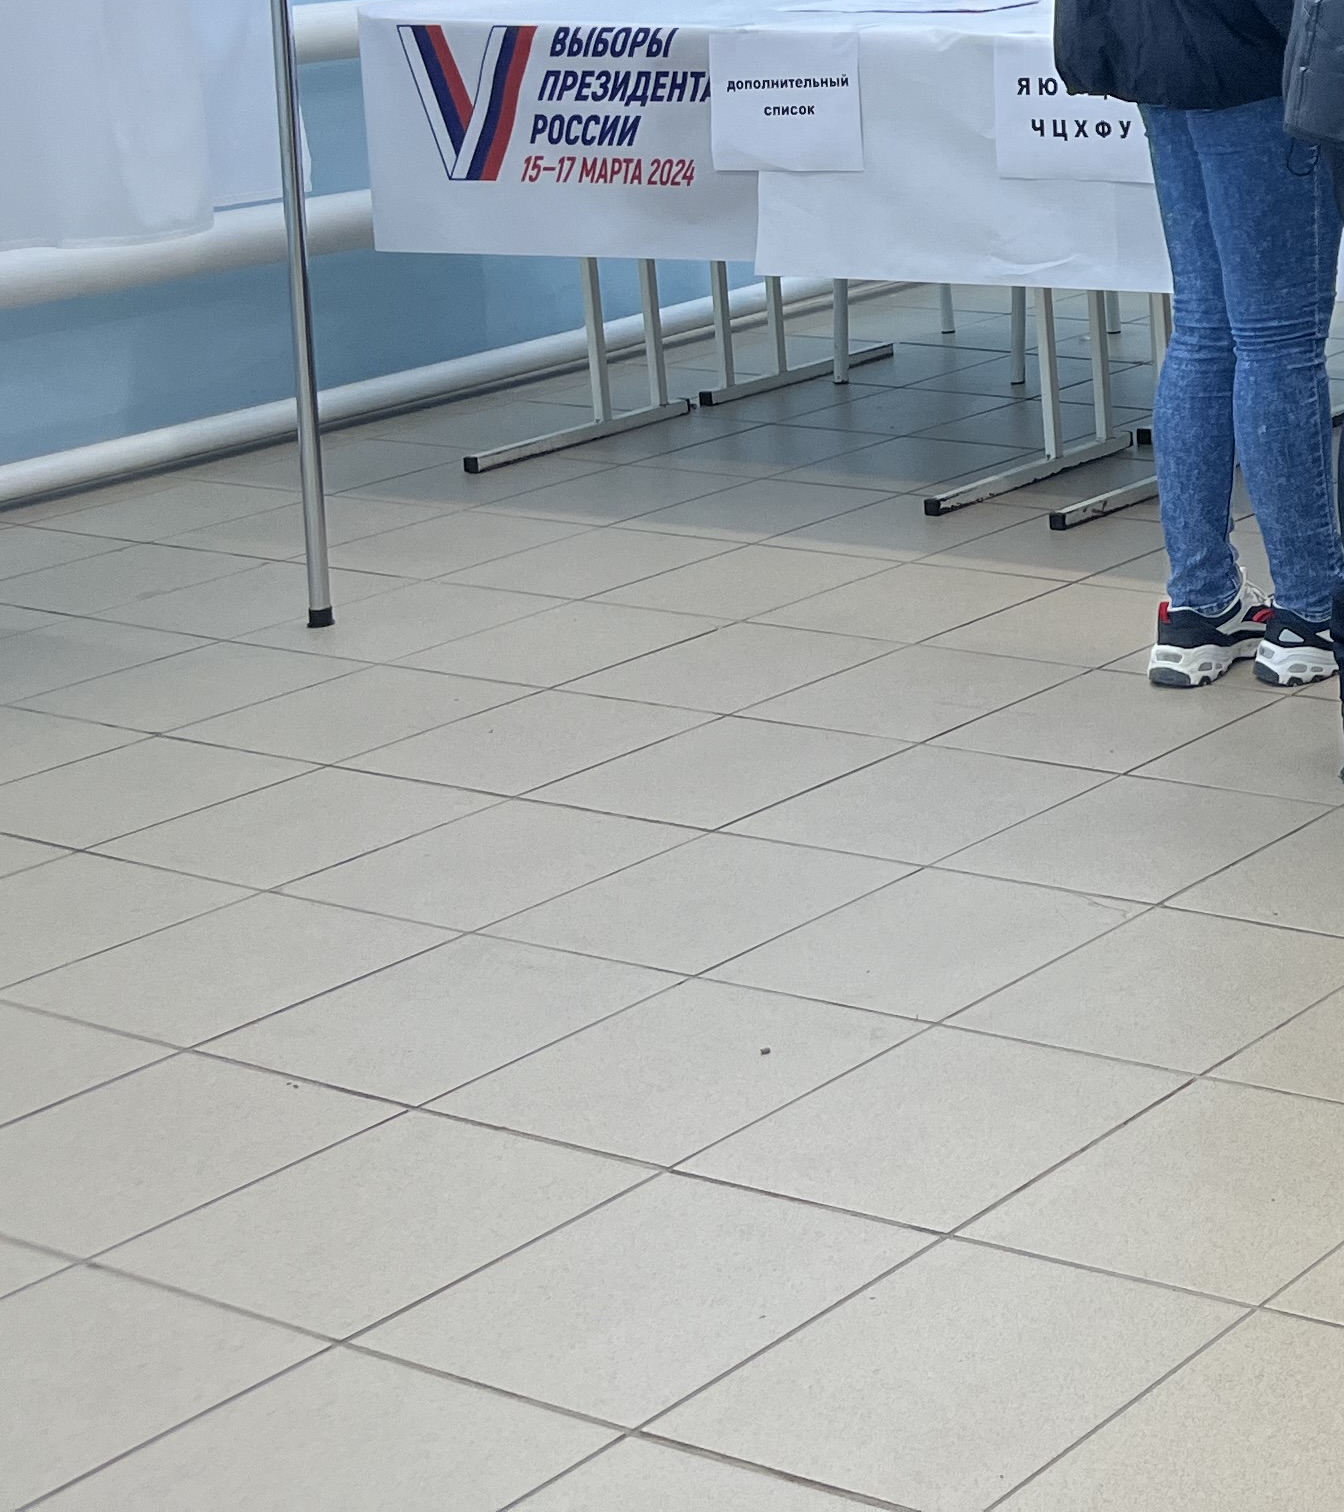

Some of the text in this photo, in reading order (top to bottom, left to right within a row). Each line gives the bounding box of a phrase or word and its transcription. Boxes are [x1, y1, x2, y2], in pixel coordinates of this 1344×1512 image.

[549, 26, 680, 58] ВЫБОРЫ
[726, 73, 849, 93] дополнительный
[763, 104, 816, 117] список
[529, 113, 642, 147] РОССИИ
[578, 157, 643, 185] МАРТА
[647, 158, 696, 187] 2024
